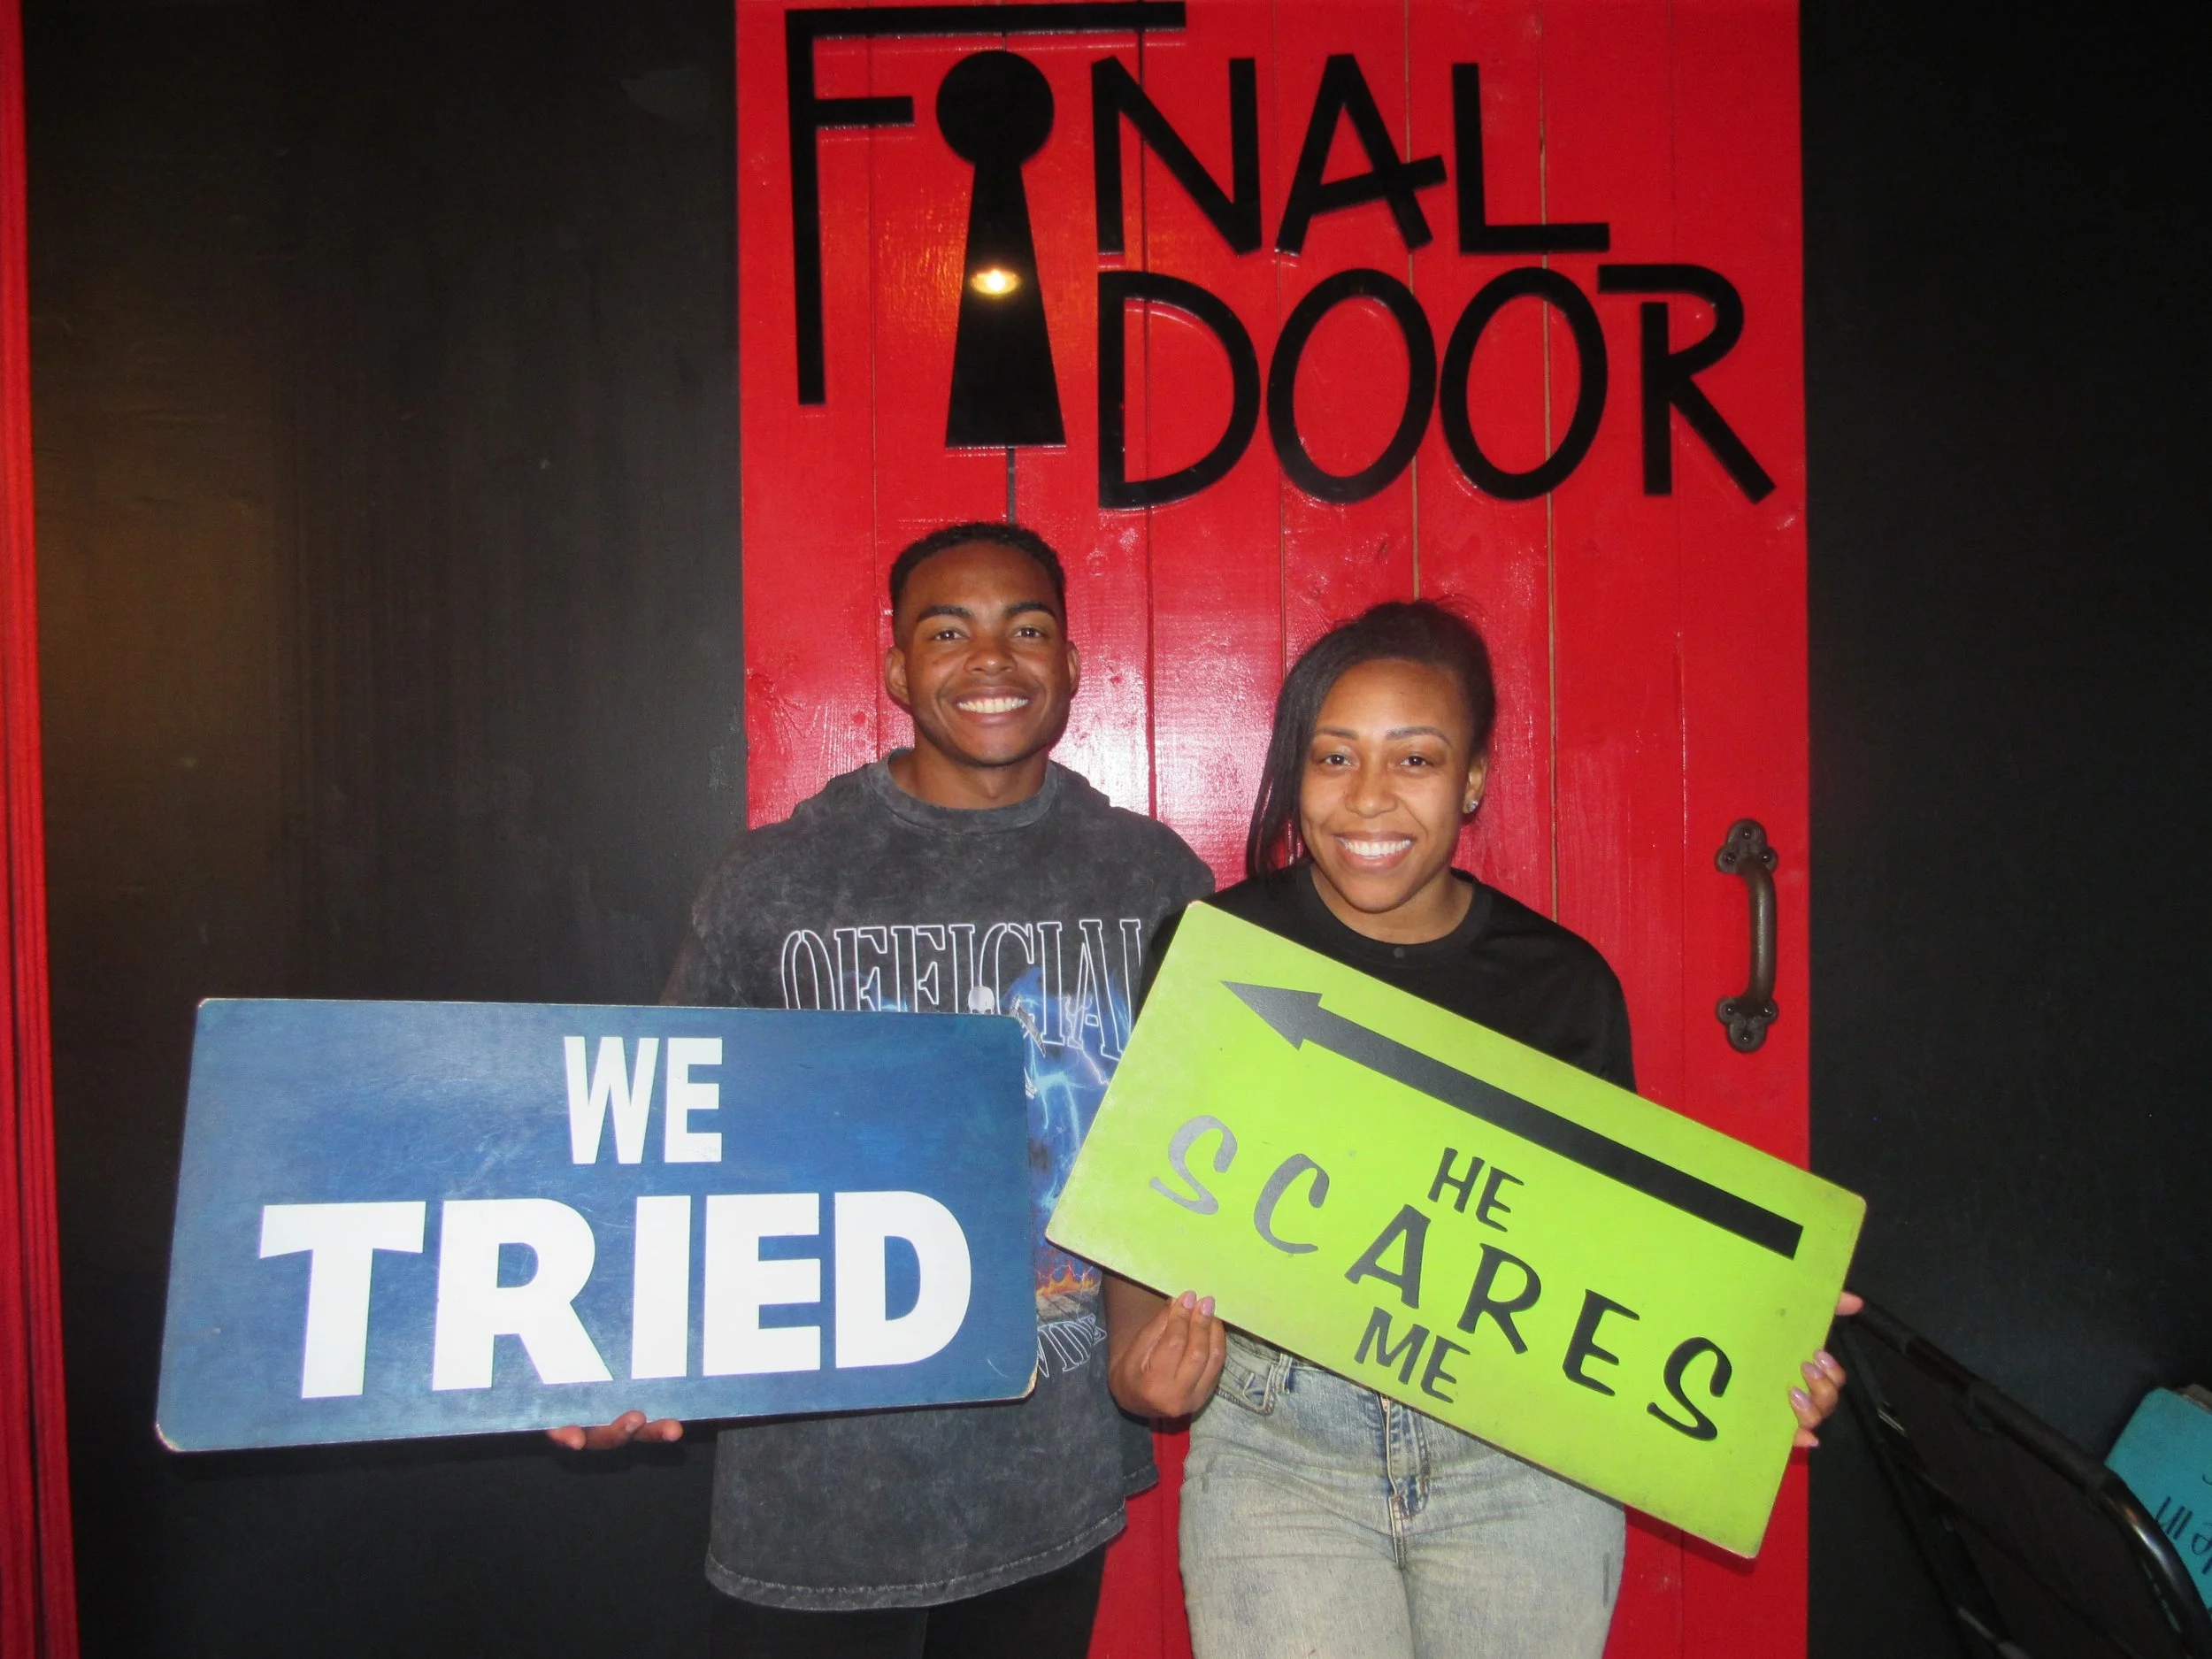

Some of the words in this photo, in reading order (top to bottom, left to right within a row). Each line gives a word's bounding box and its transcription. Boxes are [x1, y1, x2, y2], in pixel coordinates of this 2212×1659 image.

[1097, 263, 1776, 509] DOOR
[565, 1036, 723, 1164] WE
[1428, 1147, 1524, 1232] HE
[259, 1191, 972, 1399] TRIED
[1149, 1116, 1732, 1440] SCARES
[1355, 1309, 1471, 1403] ME
